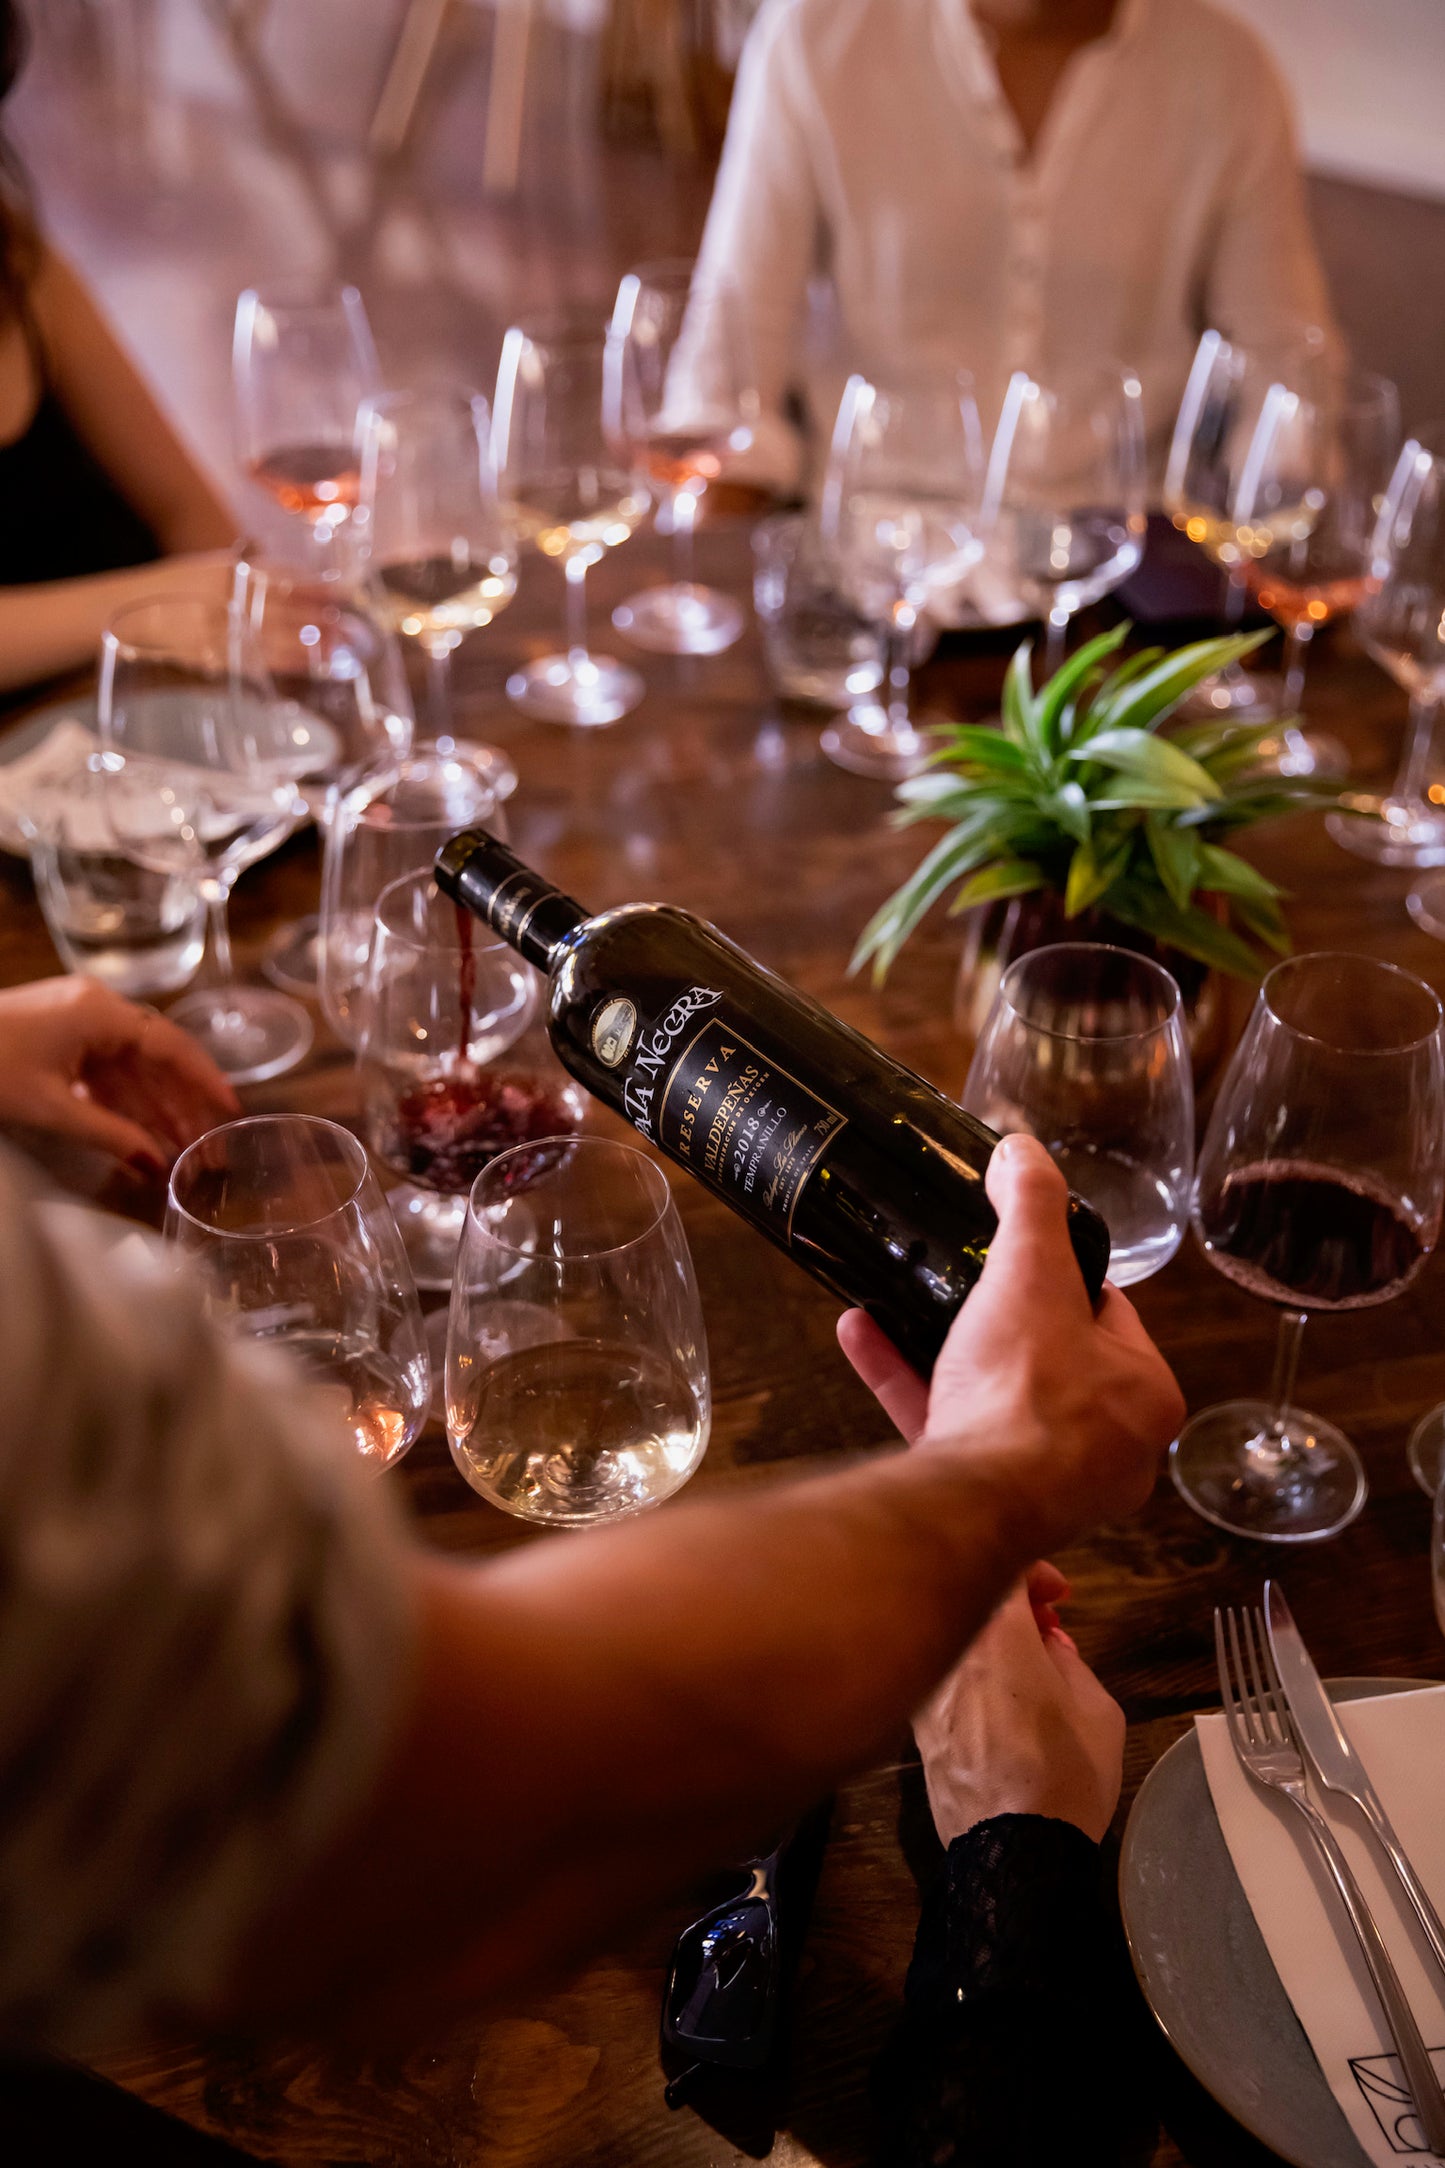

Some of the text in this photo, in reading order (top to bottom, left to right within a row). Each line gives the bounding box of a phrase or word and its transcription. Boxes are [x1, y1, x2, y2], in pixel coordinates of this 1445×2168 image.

[635, 986, 724, 1081] NEGRA
[679, 1044, 736, 1157] RESERVA
[704, 1065, 759, 1171] VALDEPEÑAS
[735, 1106, 745, 1118] DE
[743, 1072, 770, 1103] ORIGEN
[813, 1119, 831, 1136] 750
[734, 1117, 760, 1164] 2018
[744, 1107, 787, 1193] TEMPRANILLO
